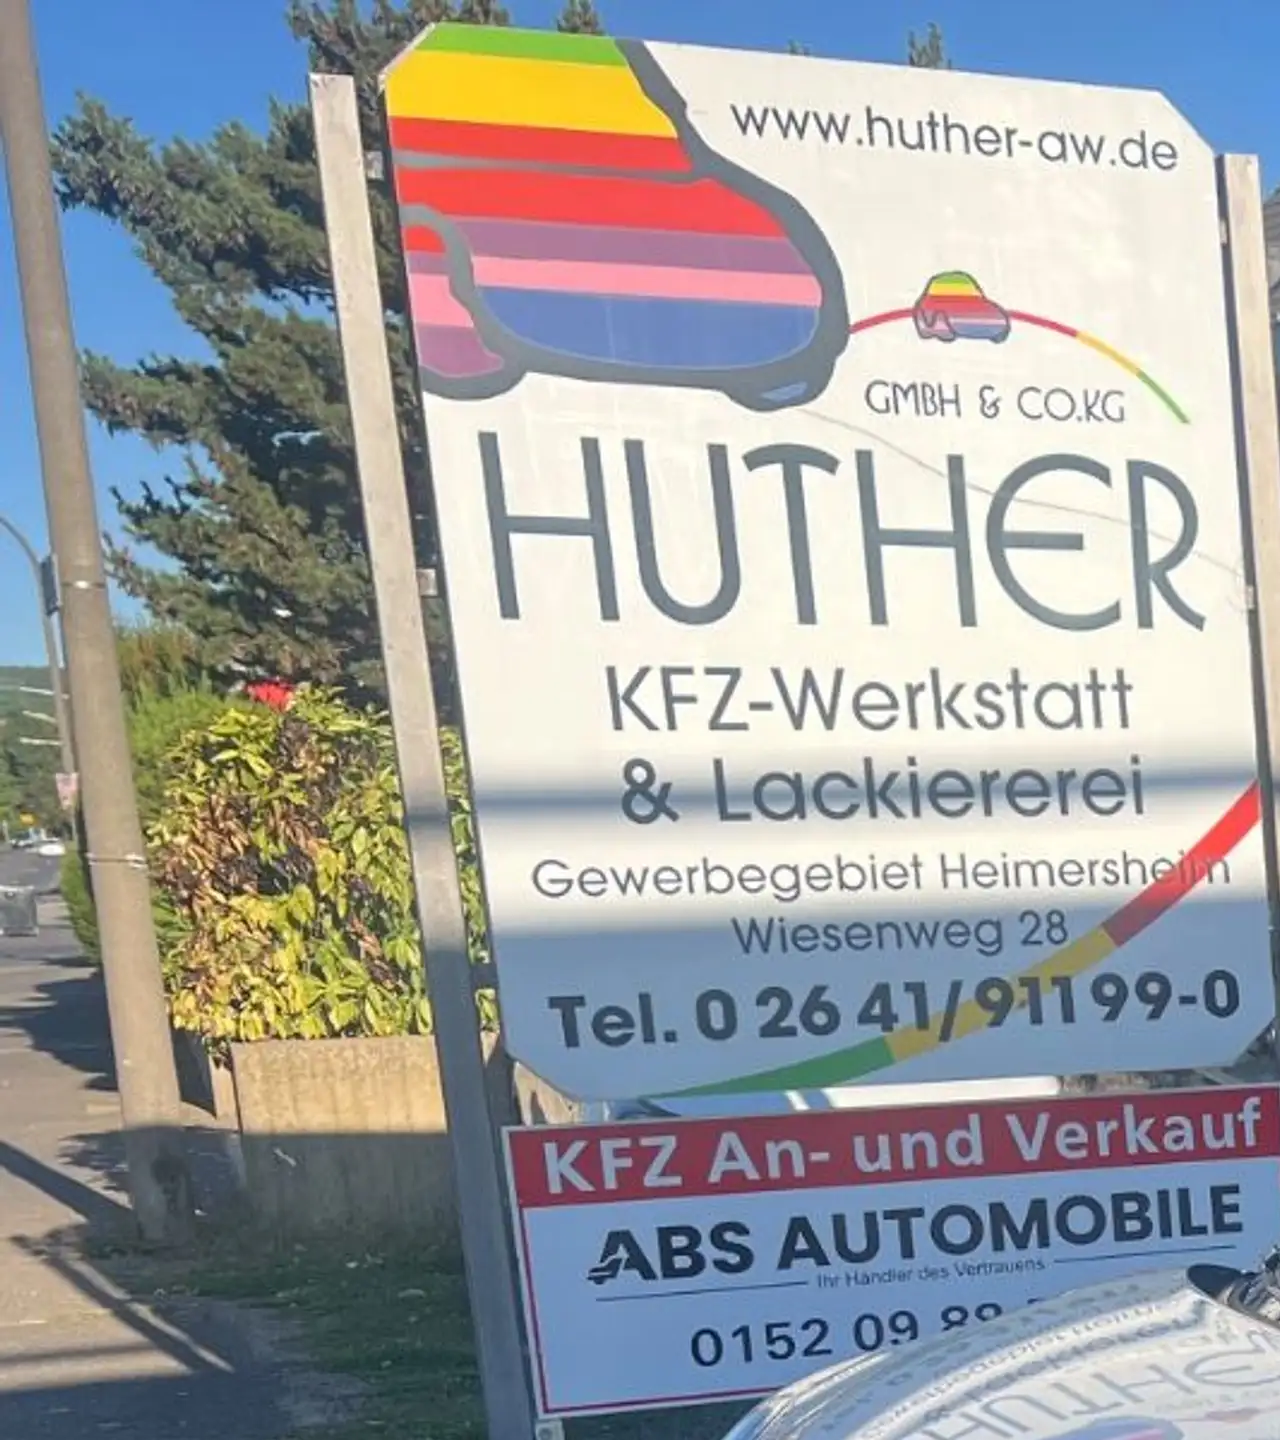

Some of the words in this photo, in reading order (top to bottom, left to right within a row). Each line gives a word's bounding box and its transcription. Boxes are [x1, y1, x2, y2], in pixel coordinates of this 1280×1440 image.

[730, 103, 1178, 170] www.huther-aw.de
[864, 379, 962, 418] GMBH
[978, 385, 1001, 418] &
[1017, 386, 1126, 423] CO.KG
[477, 430, 1206, 632] HUTHER
[605, 665, 1134, 732] KFZ-Werkstatt
[620, 758, 680, 825] &
[713, 754, 1145, 822] Lackiererei
[531, 853, 924, 900] Gewerbegebiet
[939, 849, 1231, 891] Heimersheim
[730, 912, 1003, 957] Wiesenweg
[1019, 910, 1070, 947] 28
[548, 992, 678, 1048] Tel.
[542, 1134, 683, 1195] KFZ
[707, 1129, 830, 1185] An-
[854, 1113, 985, 1174] und
[1006, 1095, 1263, 1164] Verkauf
[586, 1219, 755, 1285] ABS
[775, 1183, 1244, 1272] AUTOMOBILE
[816, 1272, 841, 1289] Ihr
[917, 1263, 950, 1281] des
[955, 1256, 1046, 1278] Vertrauens
[690, 1316, 833, 1368] 0152
[853, 1310, 919, 1352] 09
